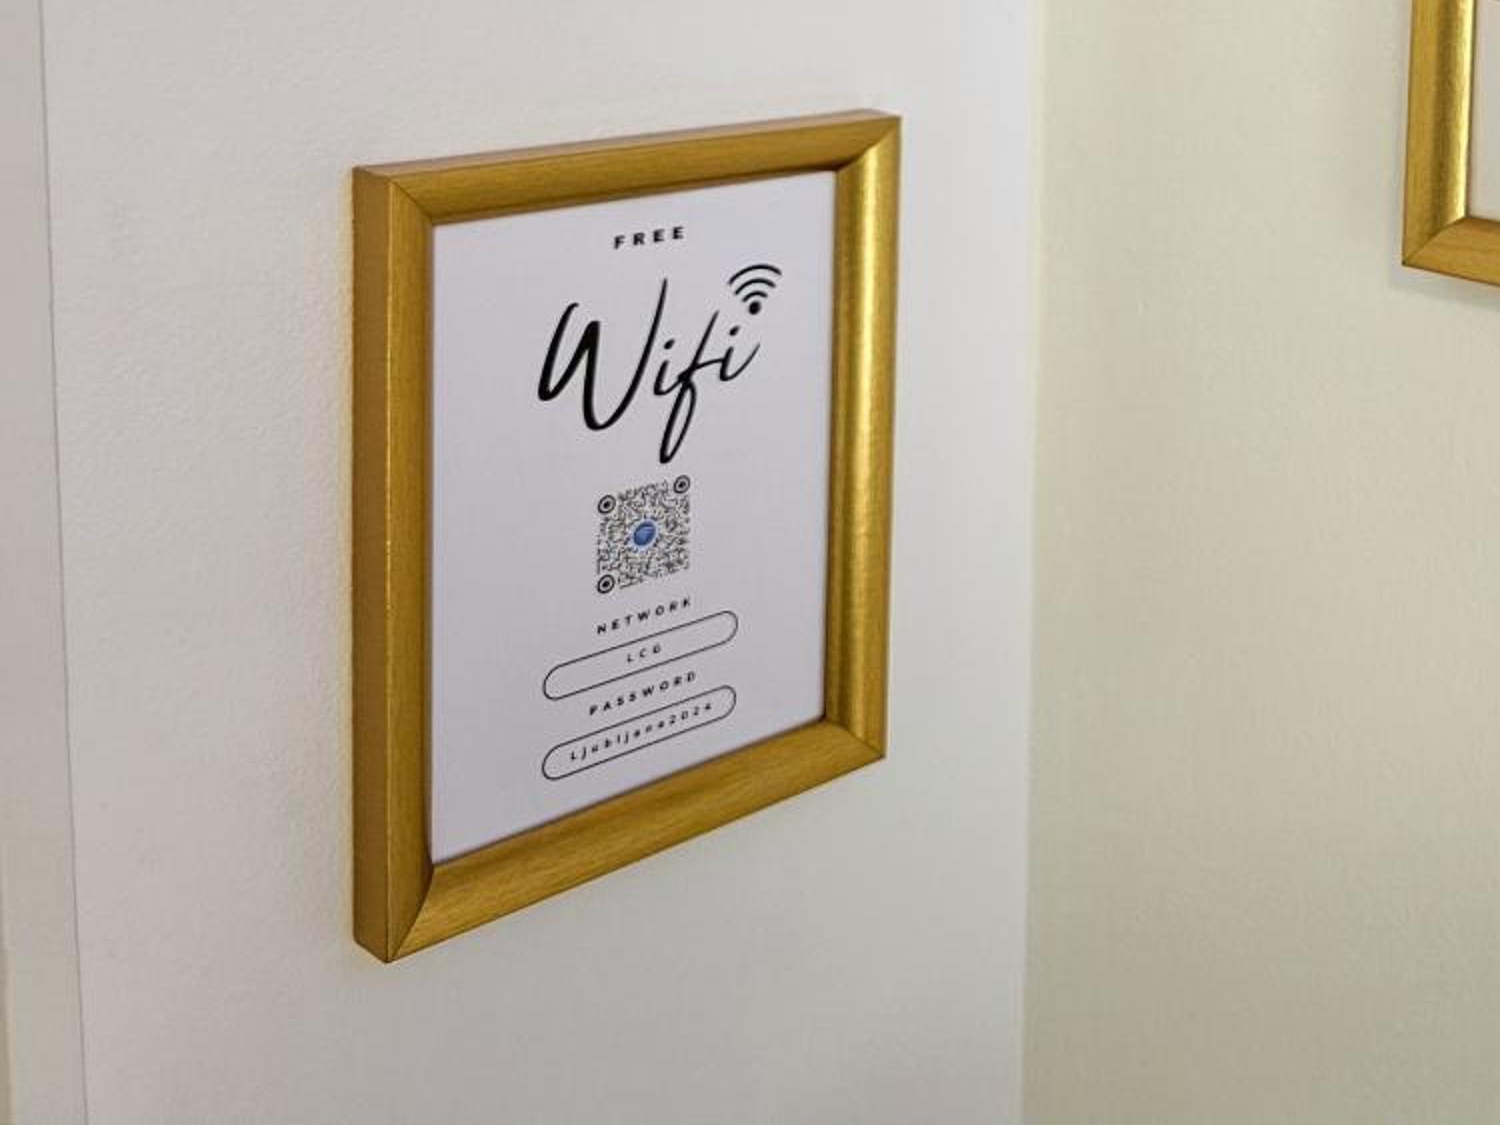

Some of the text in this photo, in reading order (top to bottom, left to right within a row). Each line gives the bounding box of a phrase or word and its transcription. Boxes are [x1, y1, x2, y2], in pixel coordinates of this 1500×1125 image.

[613, 225, 686, 250] FREE
[537, 276, 761, 464] Wifi
[597, 597, 692, 635] NETWORK
[589, 670, 697, 716] PASSWORD
